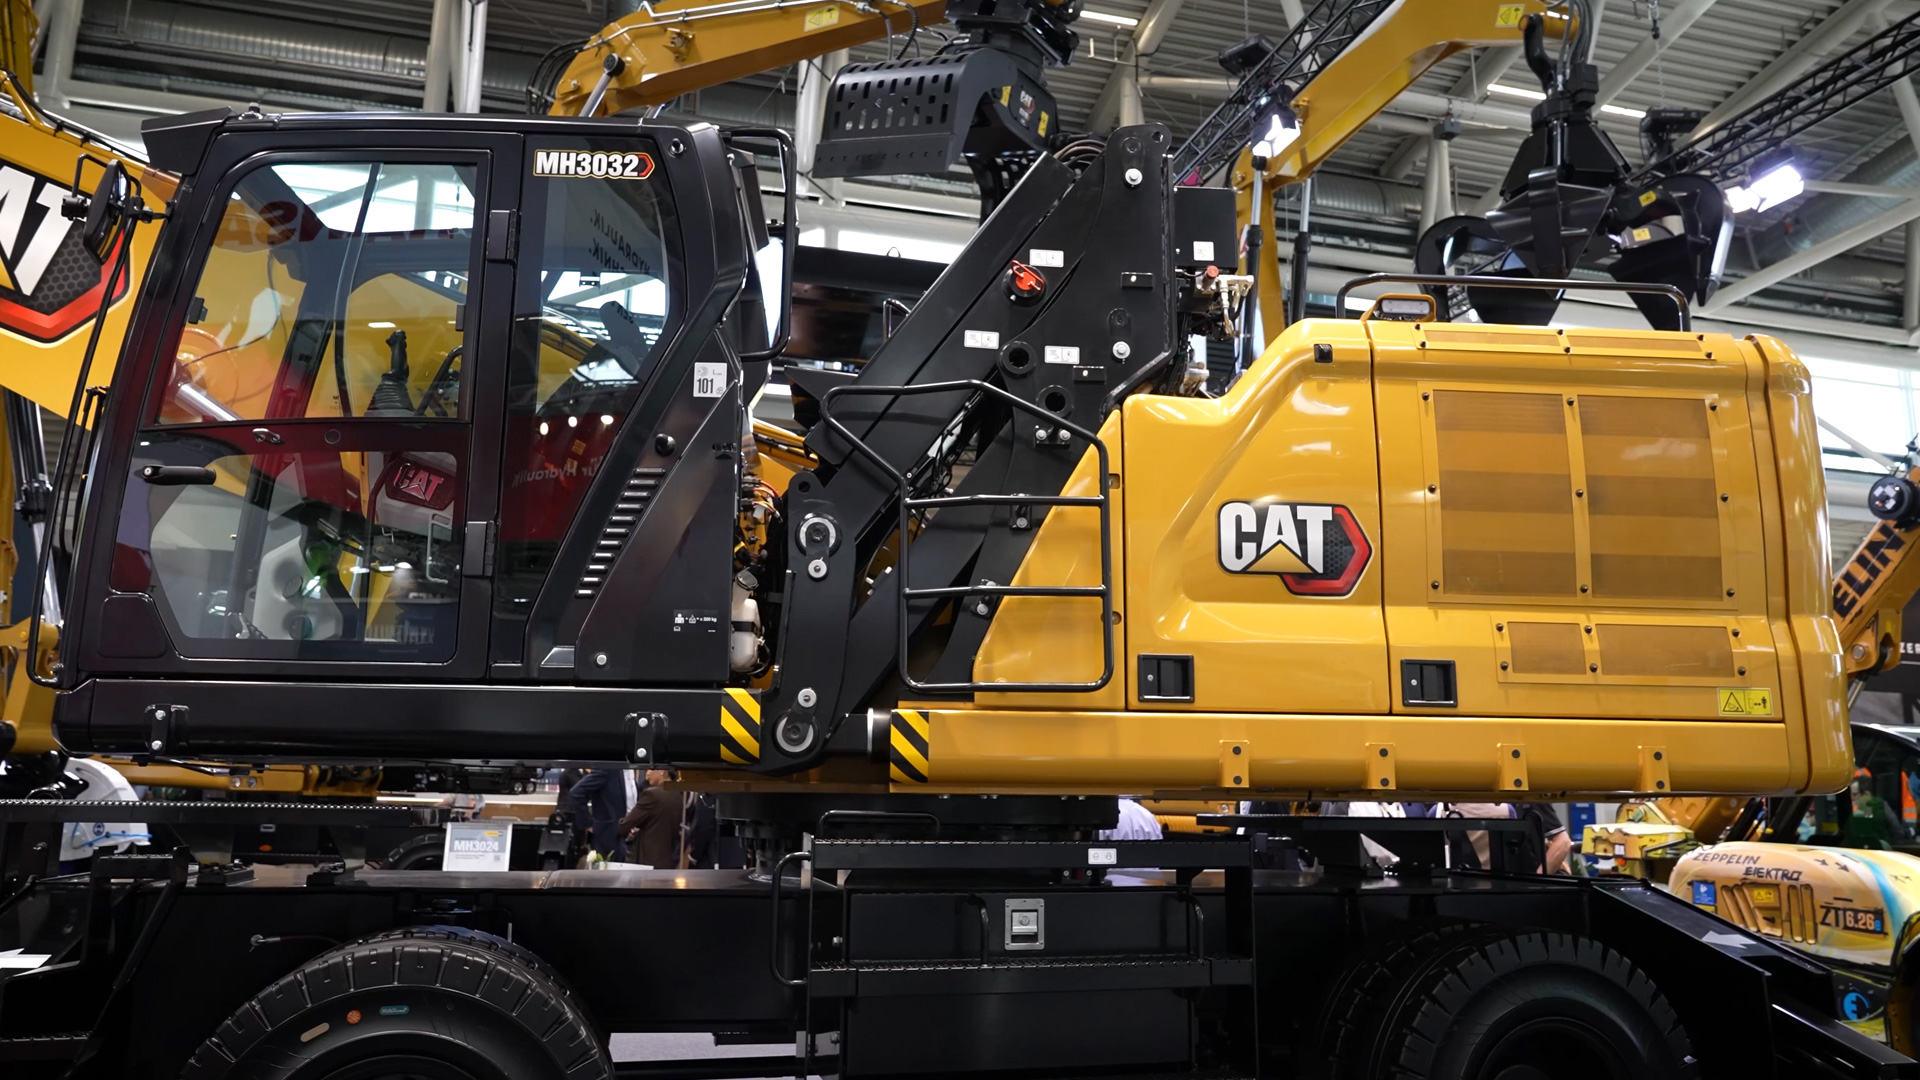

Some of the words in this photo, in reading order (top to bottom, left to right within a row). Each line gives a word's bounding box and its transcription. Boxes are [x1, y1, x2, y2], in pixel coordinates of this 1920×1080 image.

[535, 151, 639, 177] MH3032
[697, 378, 713, 394] 101
[394, 462, 444, 501] CAT
[1220, 502, 1333, 574] CAT
[454, 840, 499, 852] MH3024
[1693, 852, 1761, 866] ZEPPELIN
